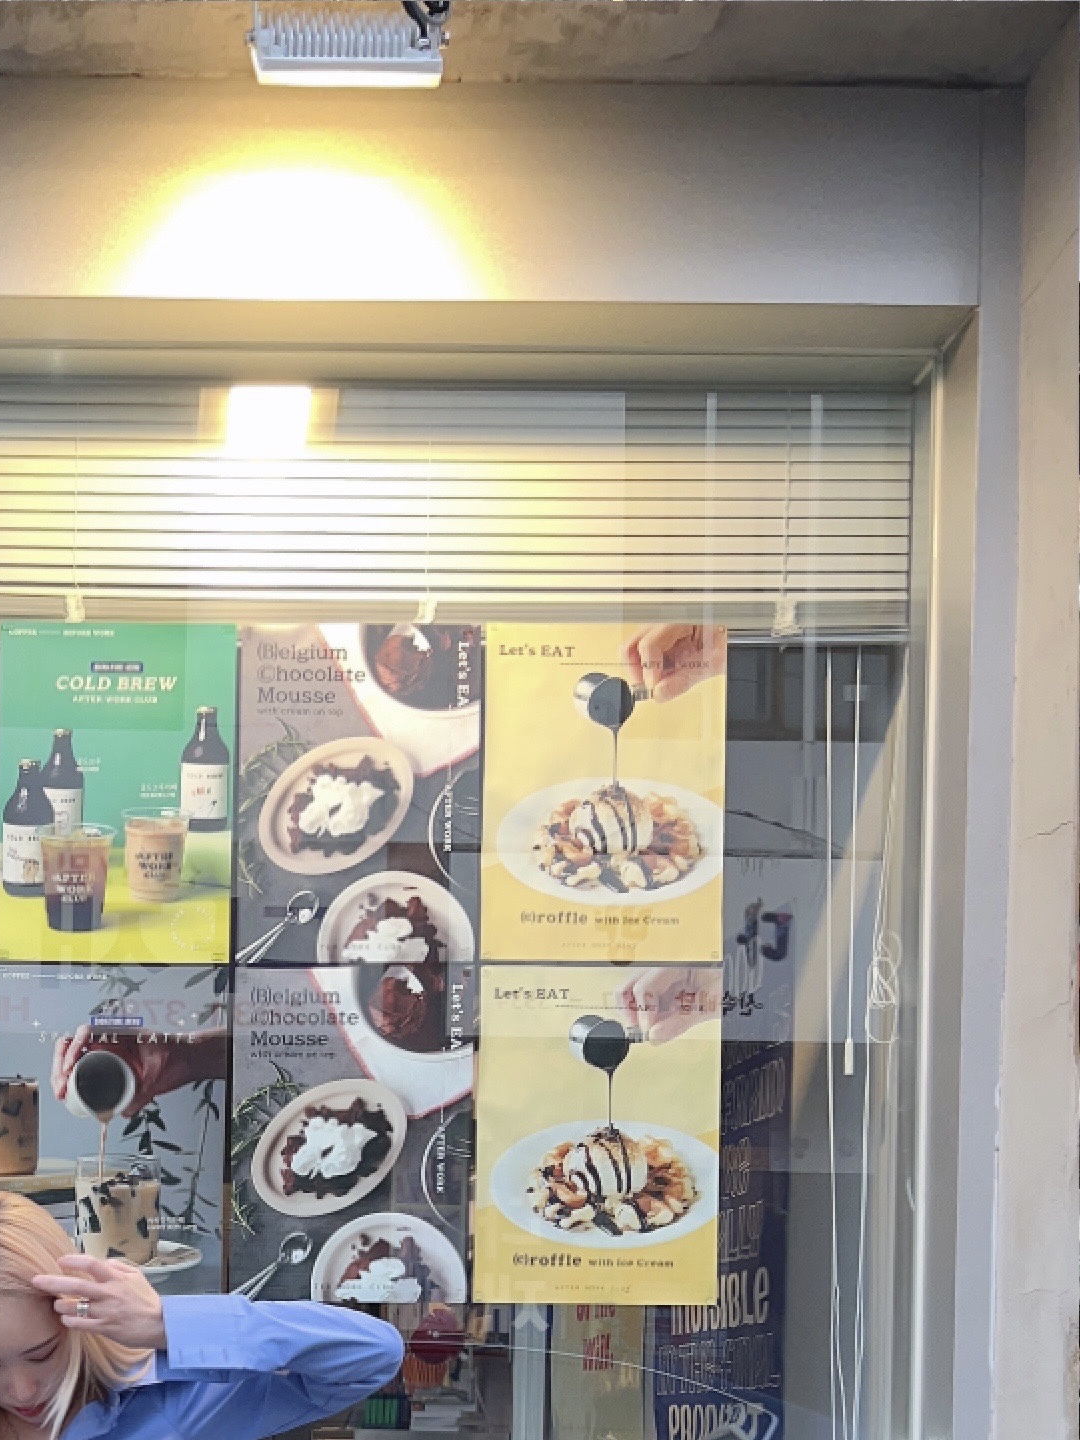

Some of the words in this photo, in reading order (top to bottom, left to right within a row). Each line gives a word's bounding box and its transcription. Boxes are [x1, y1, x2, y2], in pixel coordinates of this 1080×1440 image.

[498, 643, 536, 656] Let's
[540, 644, 576, 658] EAT
[457, 640, 472, 680] Let's
[55, 675, 112, 691] COLD
[116, 675, 178, 691] BREW
[257, 687, 336, 704] Mousse
[494, 986, 531, 1000] Let's
[535, 988, 570, 1000] EAT
[450, 983, 464, 1022] Let's
[136, 1032, 197, 1044] LATTE
[250, 1030, 329, 1047] Mousse
[588, 1258, 614, 1267] with
